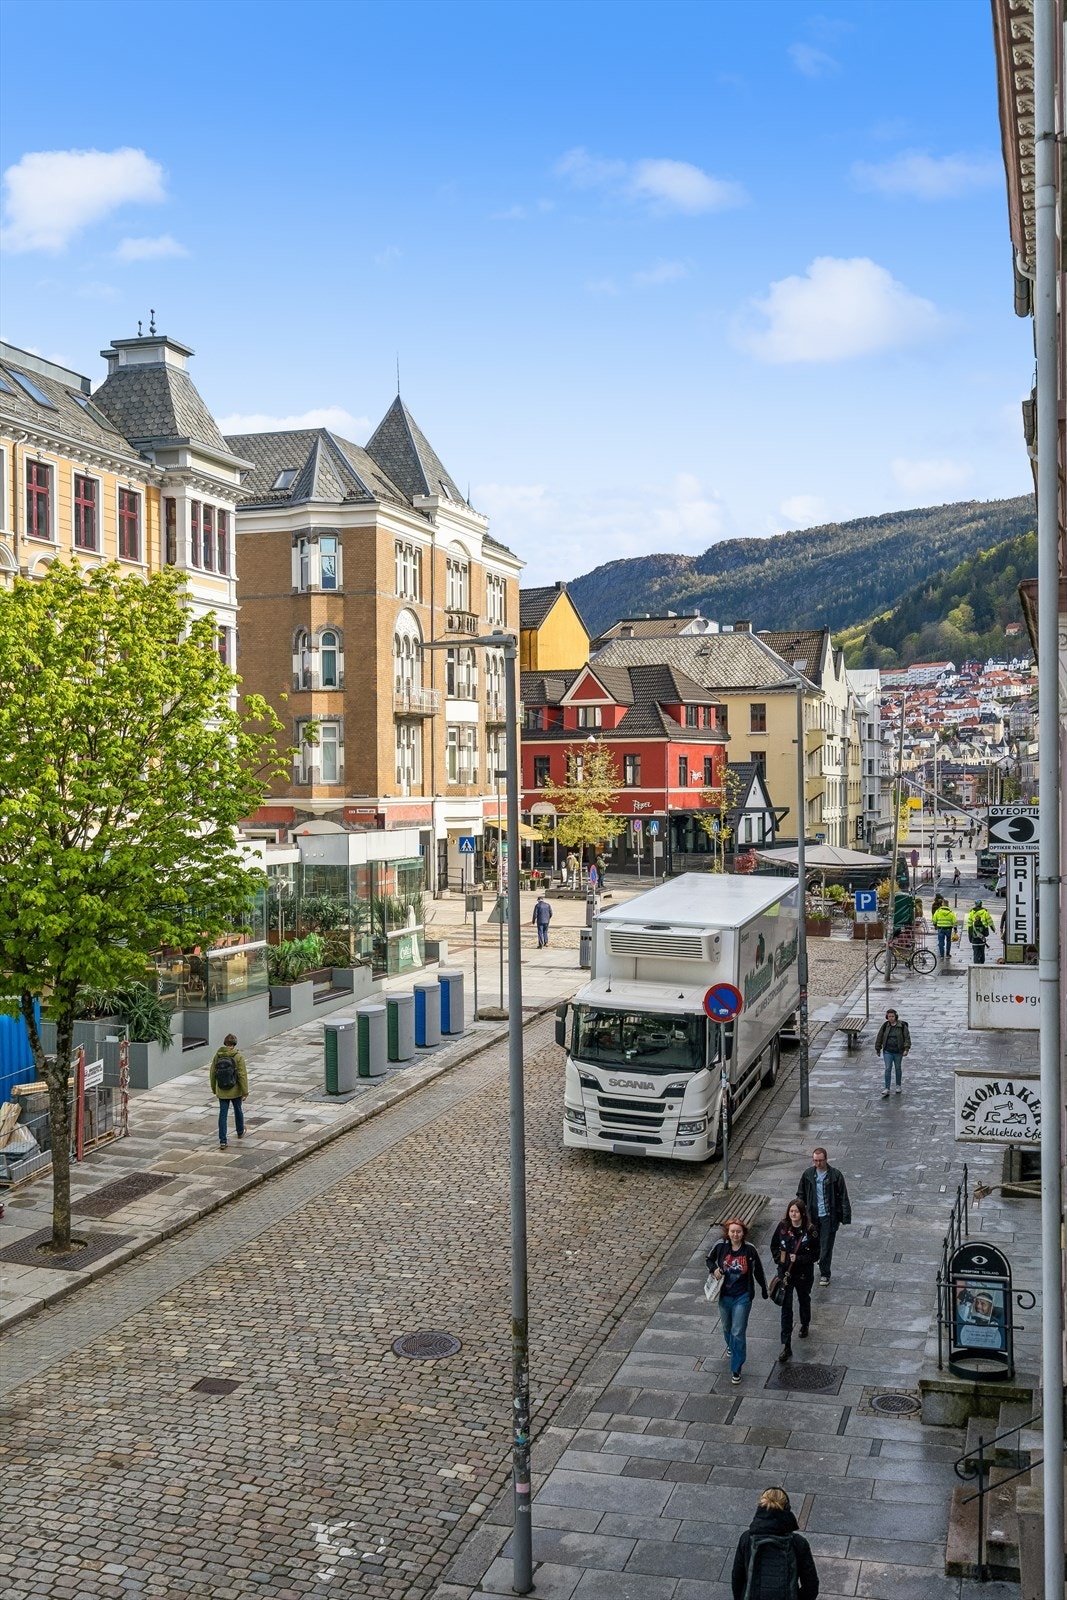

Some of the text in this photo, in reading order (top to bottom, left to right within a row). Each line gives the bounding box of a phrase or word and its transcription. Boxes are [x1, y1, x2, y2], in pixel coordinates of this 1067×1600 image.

[861, 894, 871, 909] P
[1014, 856, 1027, 943] BRILLER
[609, 1078, 655, 1090] SCANIA
